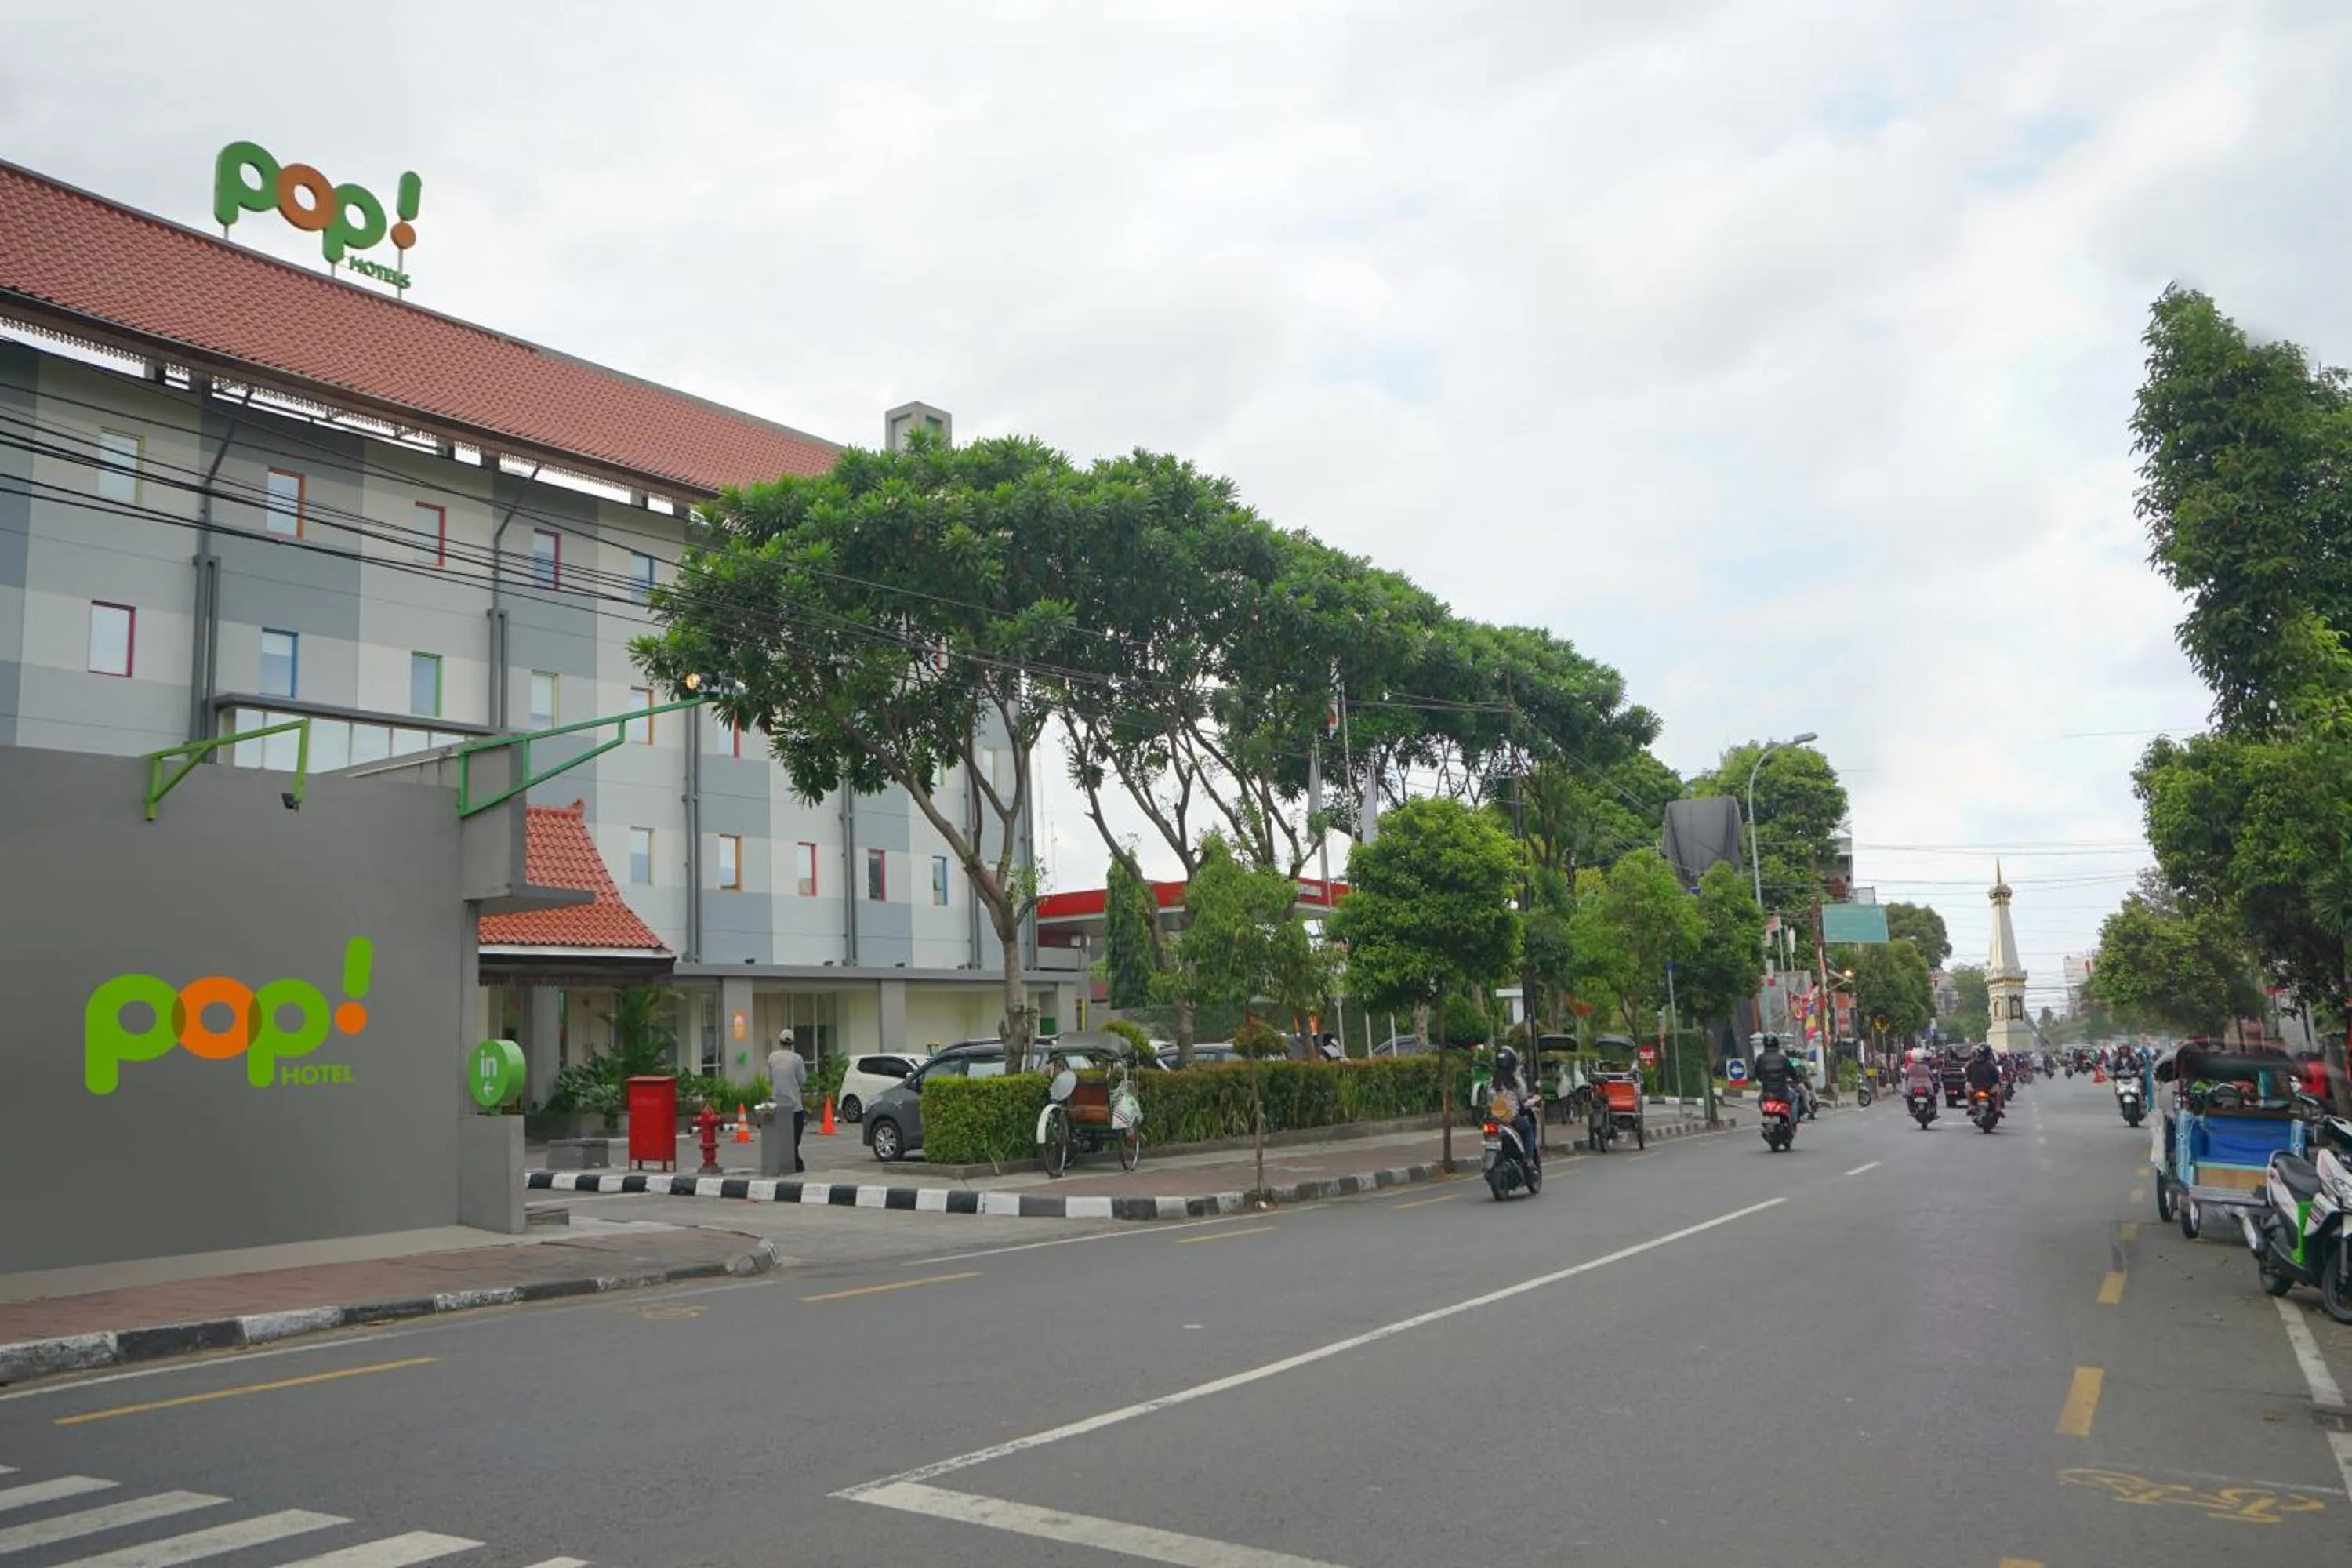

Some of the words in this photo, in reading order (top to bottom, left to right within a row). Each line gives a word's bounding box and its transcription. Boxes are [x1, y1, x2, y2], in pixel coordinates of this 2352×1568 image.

[214, 140, 422, 263] pop!
[349, 256, 411, 289] HOTELS
[85, 935, 373, 1094] pop!
[281, 1064, 354, 1086] HOTEL
[480, 1050, 498, 1079] in
